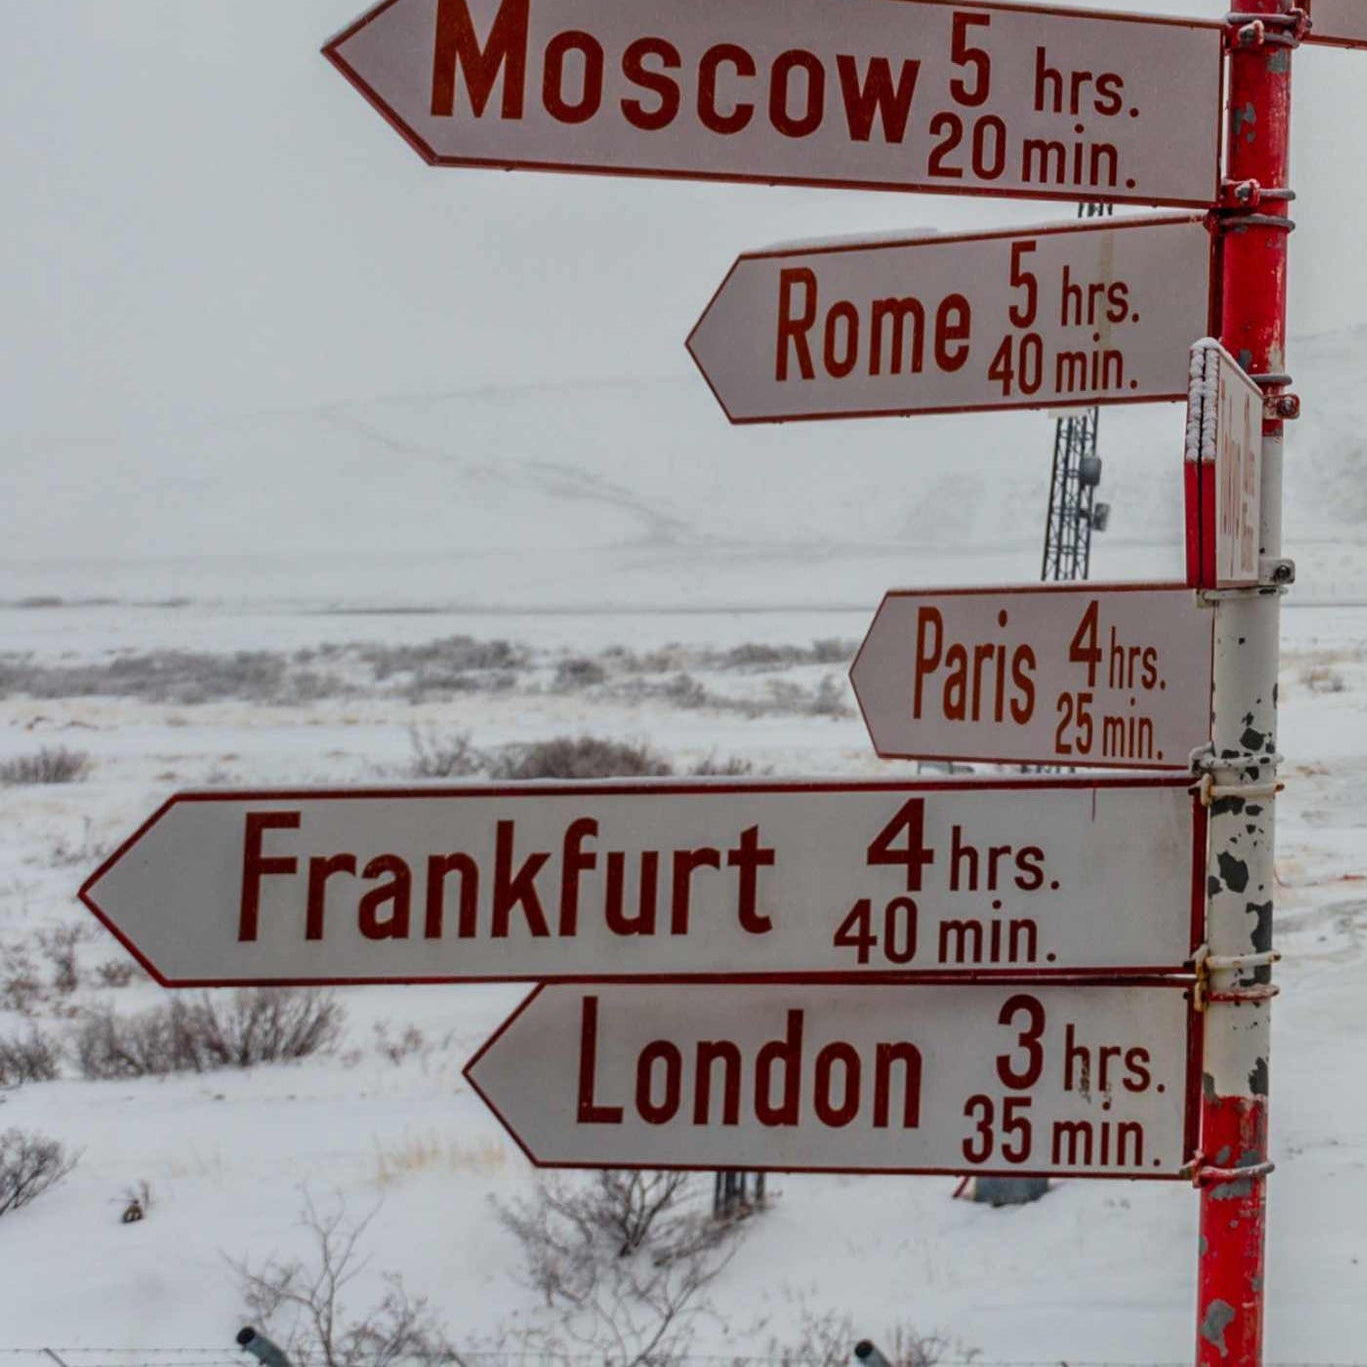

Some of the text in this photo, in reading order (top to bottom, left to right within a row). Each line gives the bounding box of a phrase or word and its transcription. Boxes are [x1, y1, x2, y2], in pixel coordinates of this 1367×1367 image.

[950, 11, 990, 107] 5
[1035, 46, 1139, 117] hrs.
[928, 112, 1136, 189] 20 min.
[776, 241, 1139, 381] Rome 5 hrs.
[988, 333, 1137, 396] 40 min.
[914, 600, 1165, 725] Paris 4 hrs.
[1056, 692, 1162, 760] 25 min.
[238, 798, 1059, 942] Frankfurt 4 hrs.
[834, 897, 1056, 964] 40 min.
[577, 994, 1164, 1128] London 3 hrs.
[963, 1095, 1160, 1166] 35 min.
